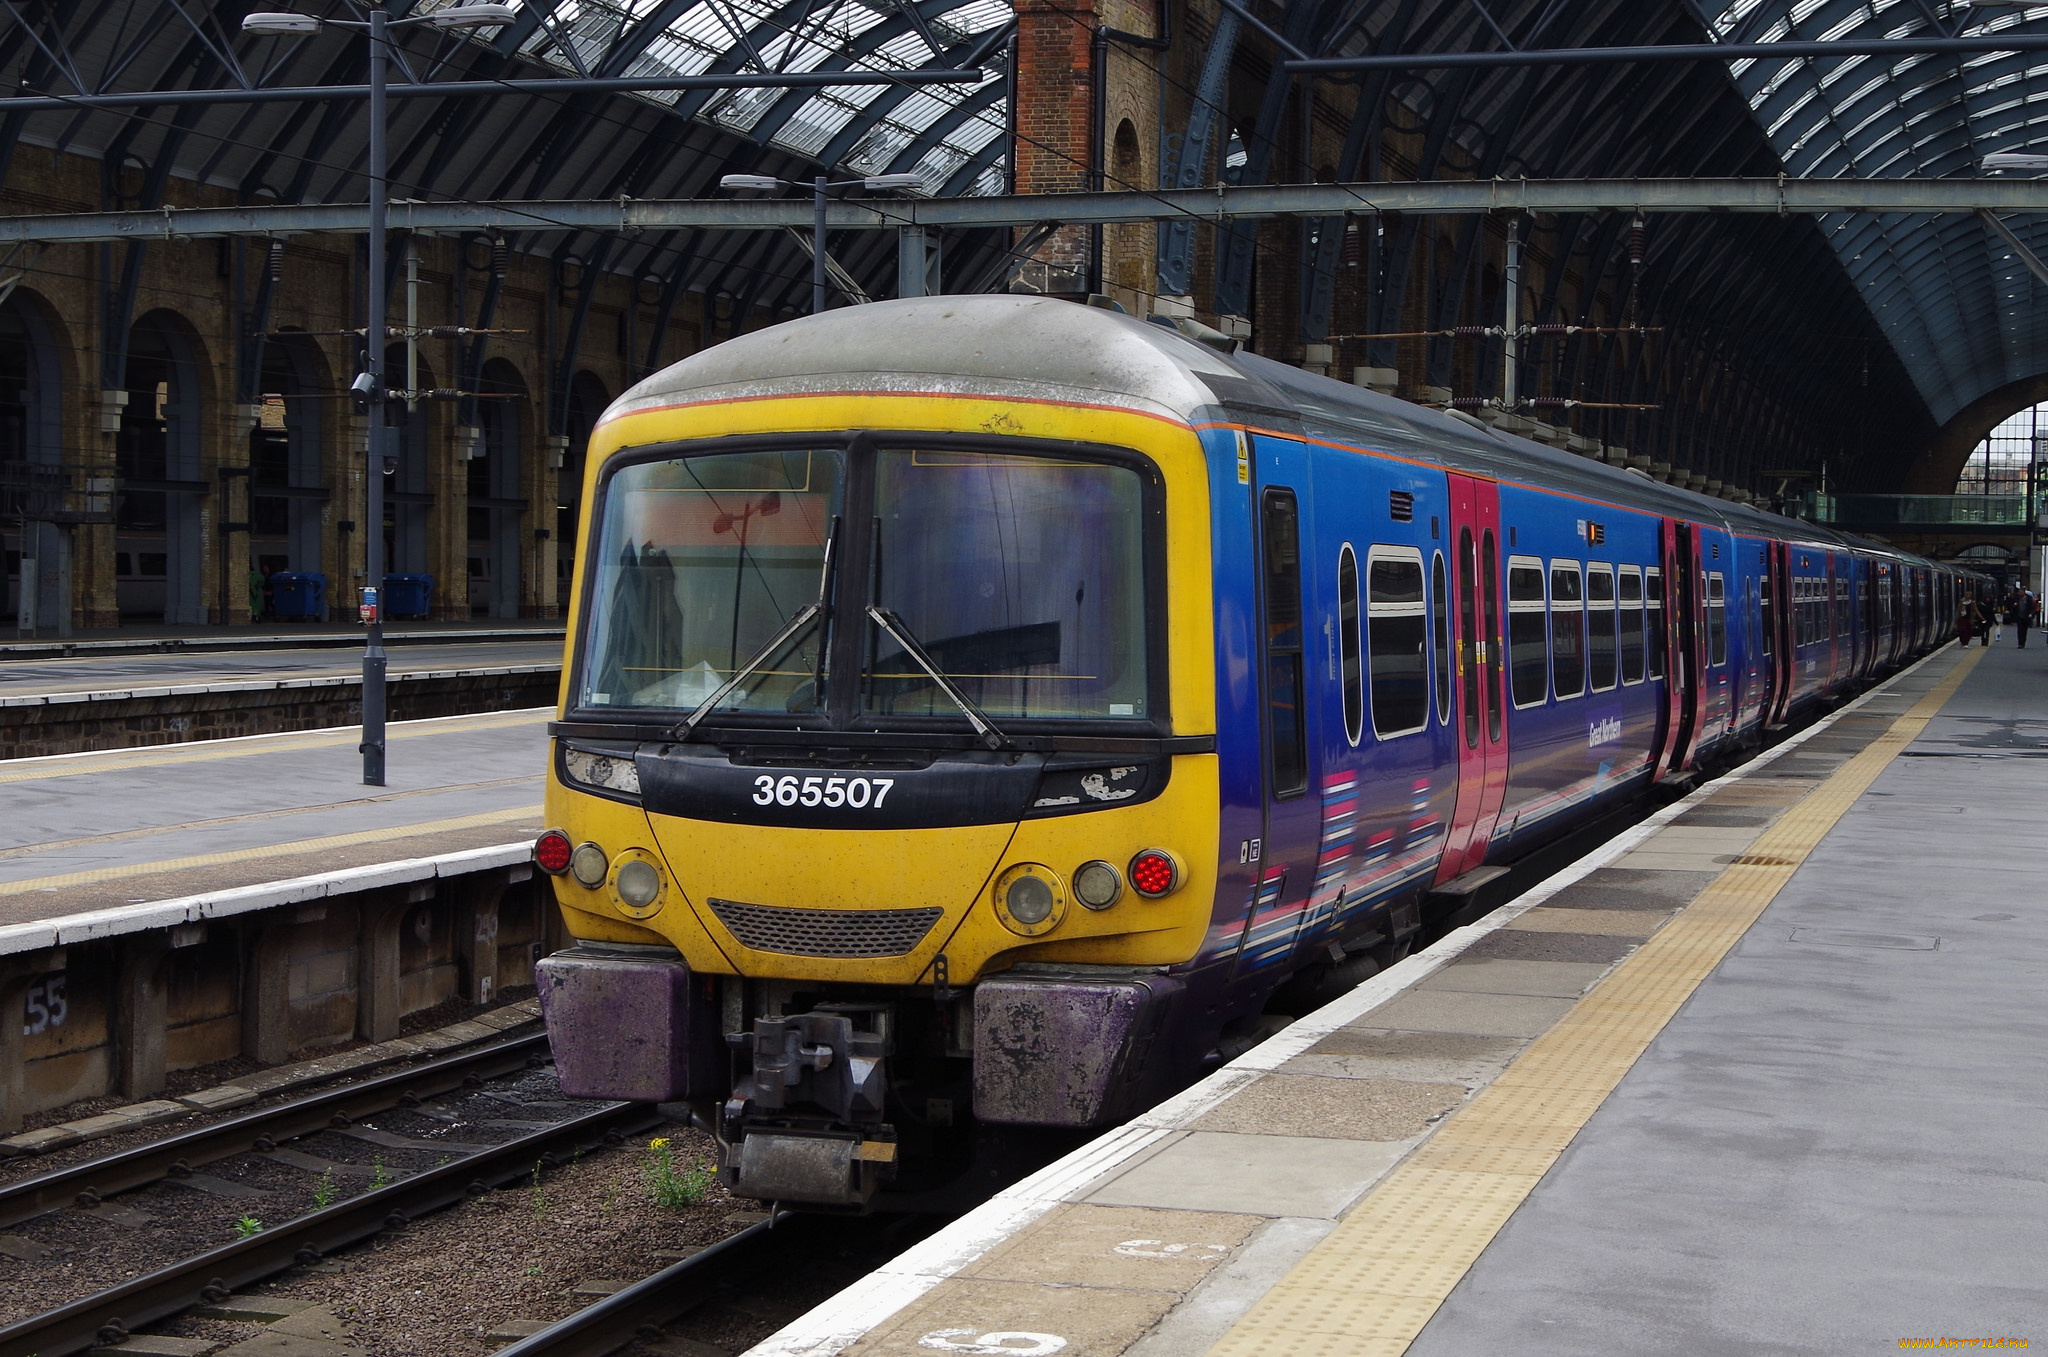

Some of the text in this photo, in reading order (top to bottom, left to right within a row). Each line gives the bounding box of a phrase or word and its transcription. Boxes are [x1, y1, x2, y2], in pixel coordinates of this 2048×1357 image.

[1589, 716, 1621, 748] Great Northern
[752, 775, 894, 809] 365507
